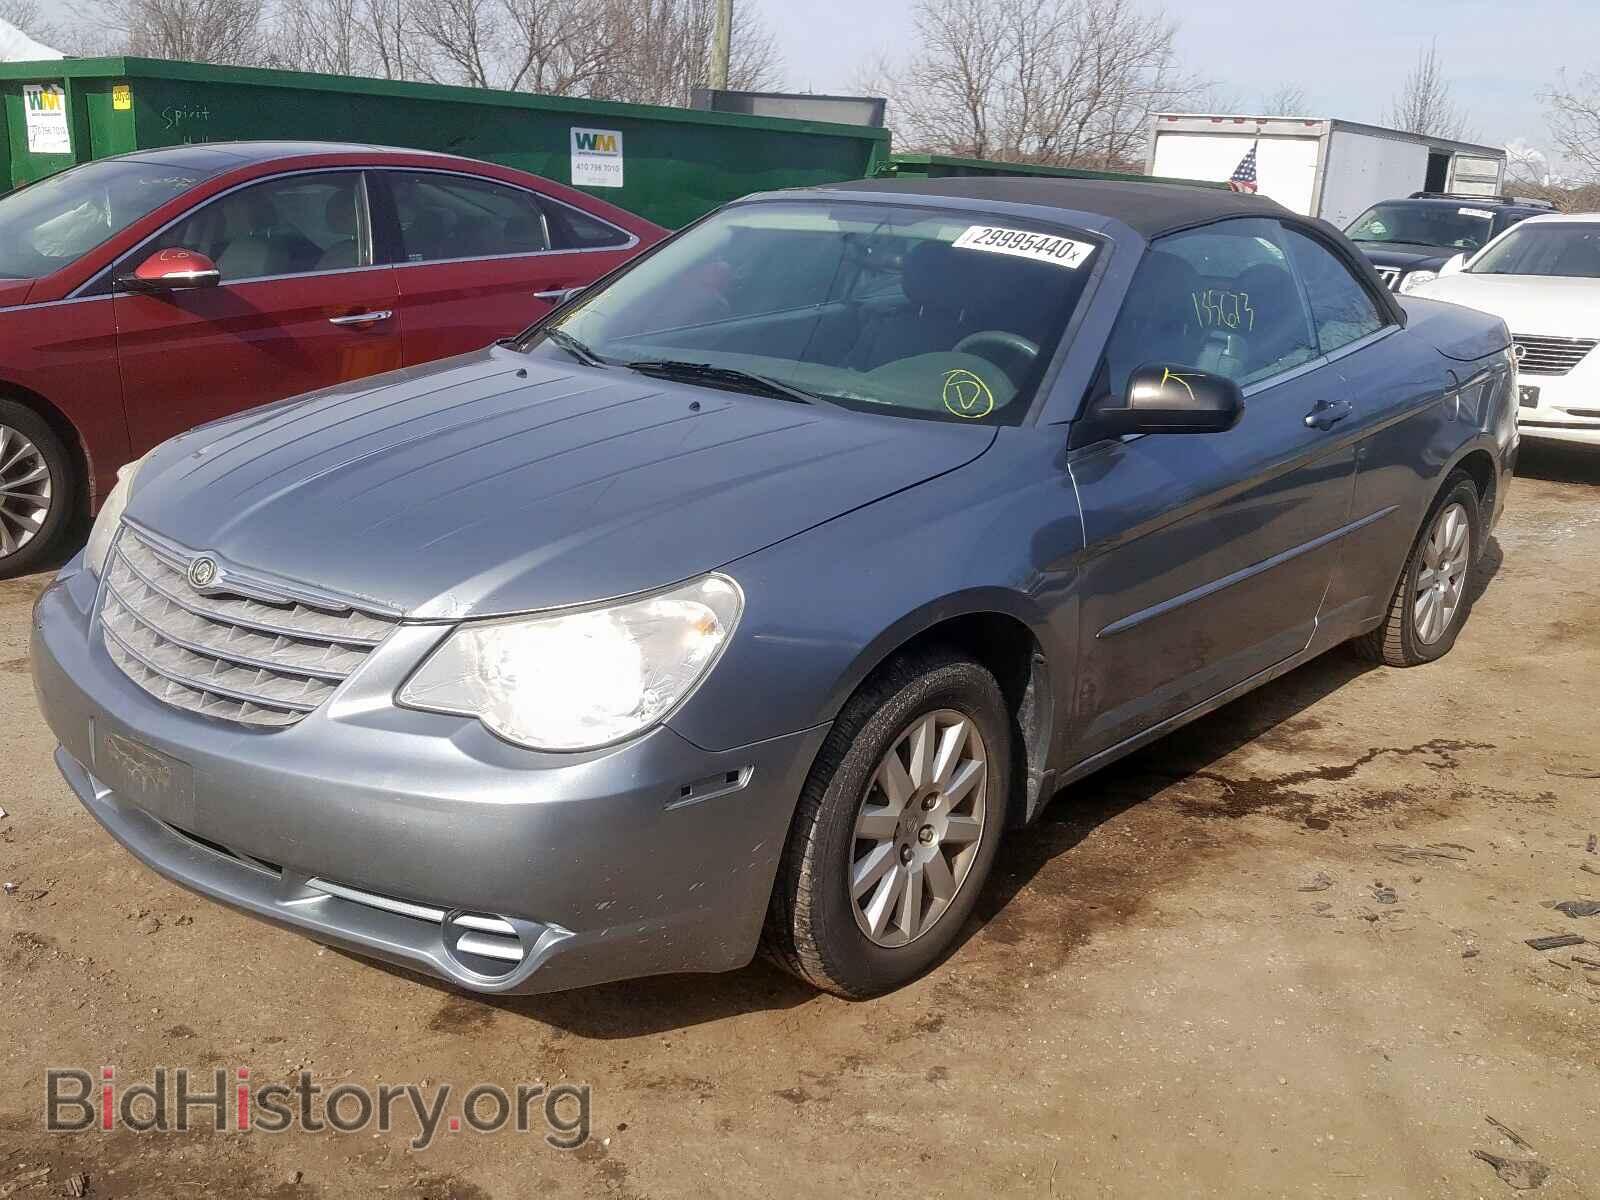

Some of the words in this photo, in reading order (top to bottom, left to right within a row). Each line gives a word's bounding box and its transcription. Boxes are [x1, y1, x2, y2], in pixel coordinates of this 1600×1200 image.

[27, 90, 63, 111] WM
[160, 104, 210, 129] Spirit
[575, 132, 617, 152] WM
[973, 228, 1074, 258] 29995440
